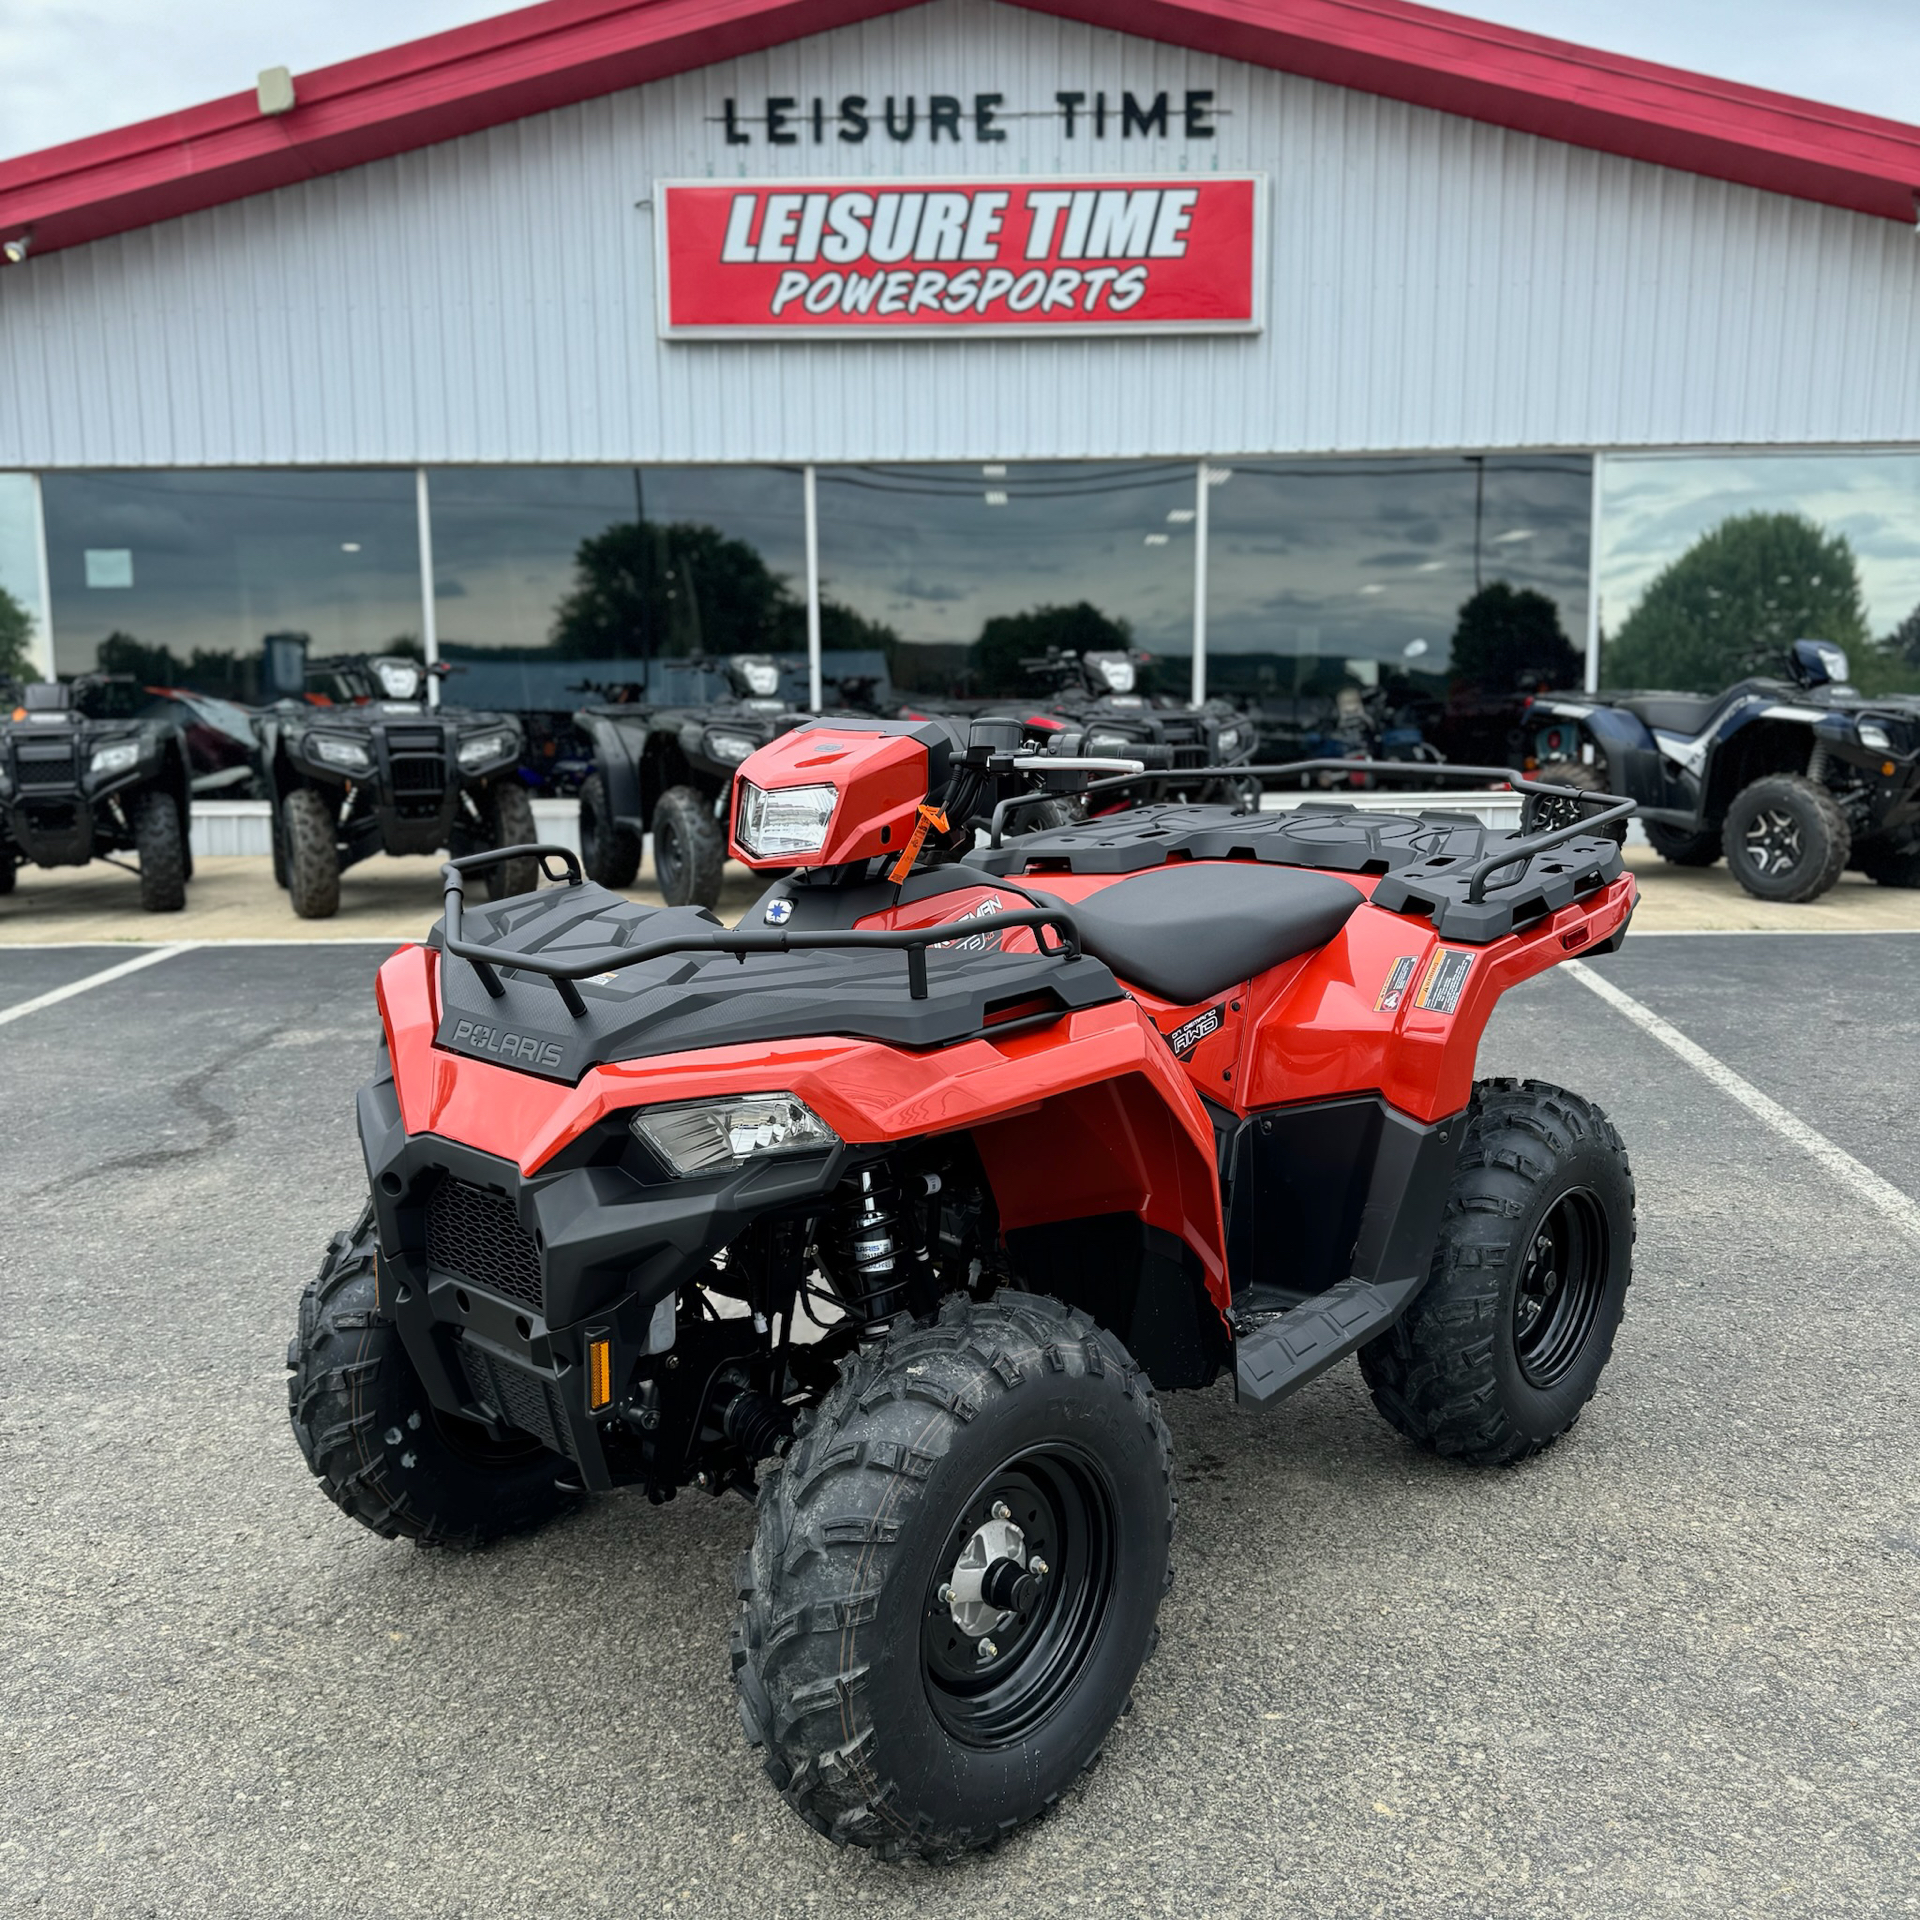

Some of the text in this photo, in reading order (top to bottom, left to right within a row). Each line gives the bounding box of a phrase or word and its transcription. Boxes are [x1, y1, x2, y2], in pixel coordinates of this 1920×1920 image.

[725, 90, 1216, 144] LEISURE TIME
[721, 188, 1199, 263] LEISURE TIME
[770, 266, 1149, 316] POWERSPORTS
[452, 1018, 564, 1068] POLARIS
[1173, 1015, 1218, 1054] AWD
